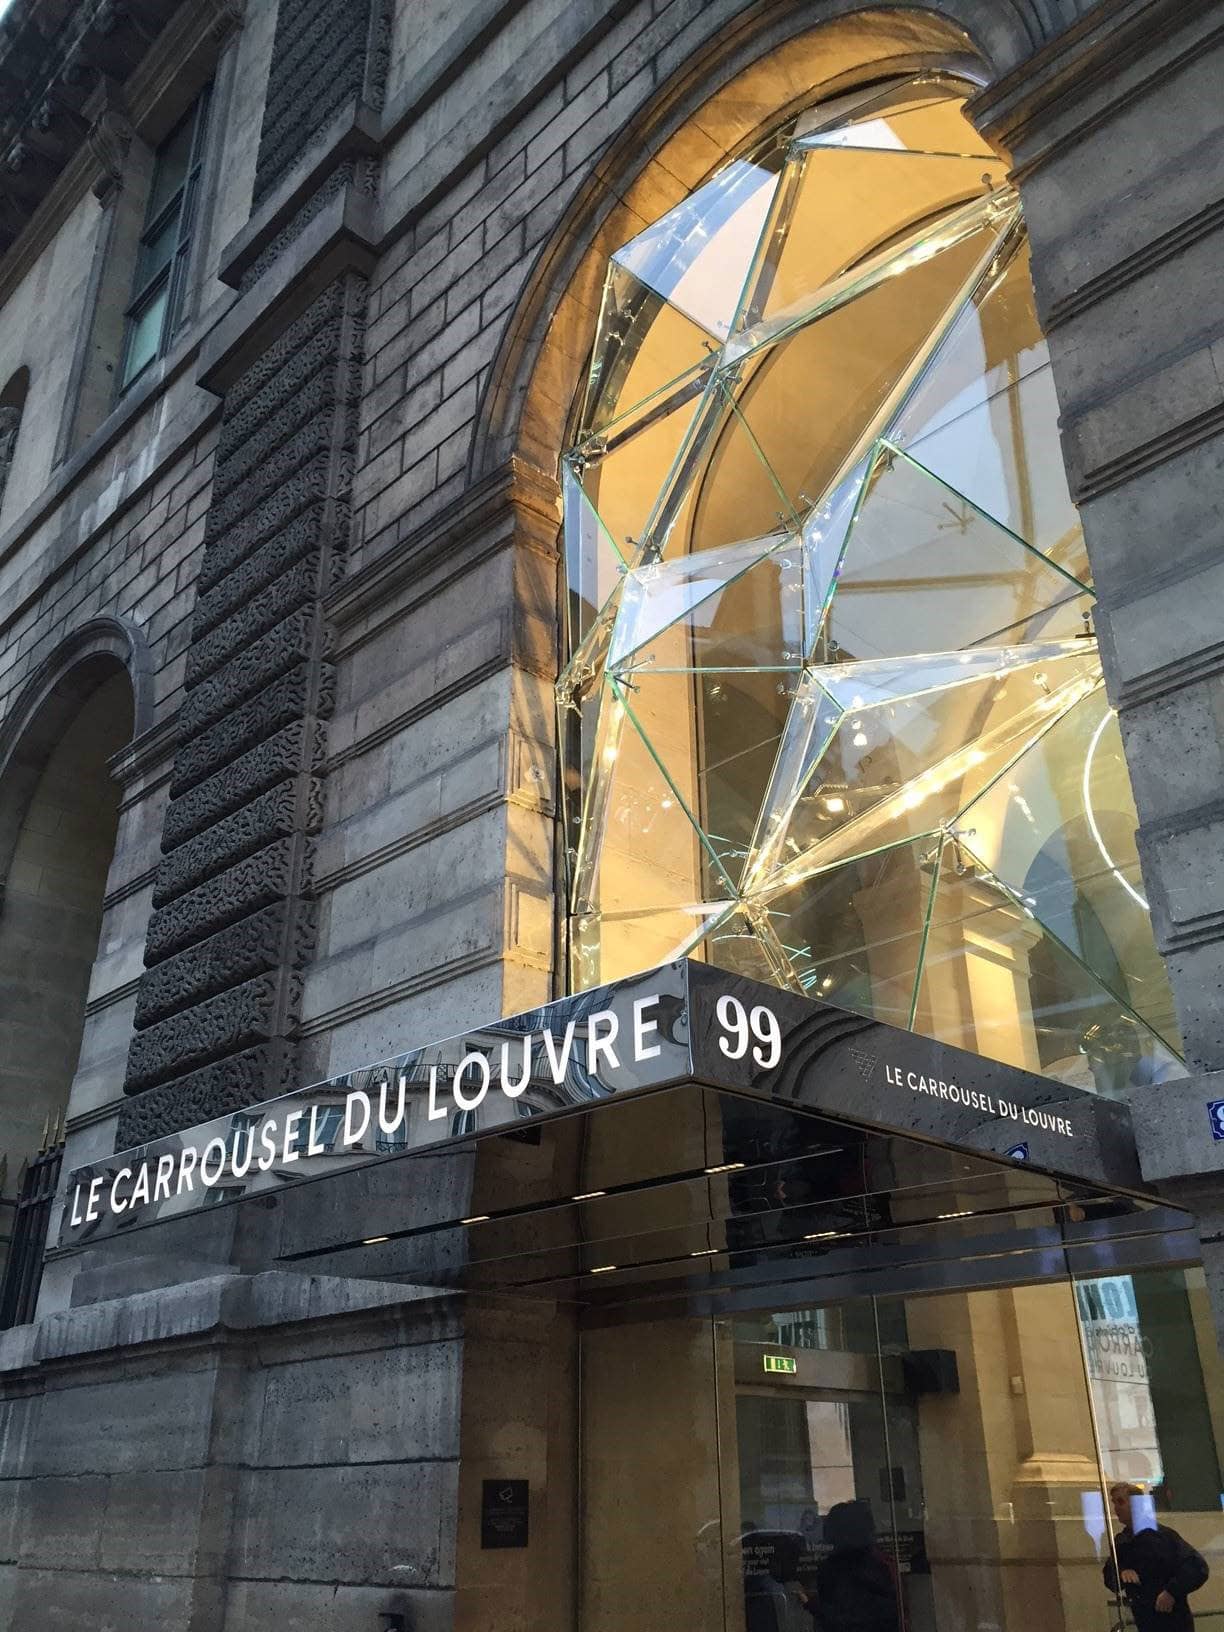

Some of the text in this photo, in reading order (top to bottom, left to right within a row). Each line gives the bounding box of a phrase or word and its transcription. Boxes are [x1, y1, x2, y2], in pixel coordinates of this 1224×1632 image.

[716, 994, 782, 1069] 99
[70, 993, 662, 1228] LE CARROUSEL DU LOUVRE
[885, 1064, 1074, 1137] LE CARROUSEL DU LOUVRE
